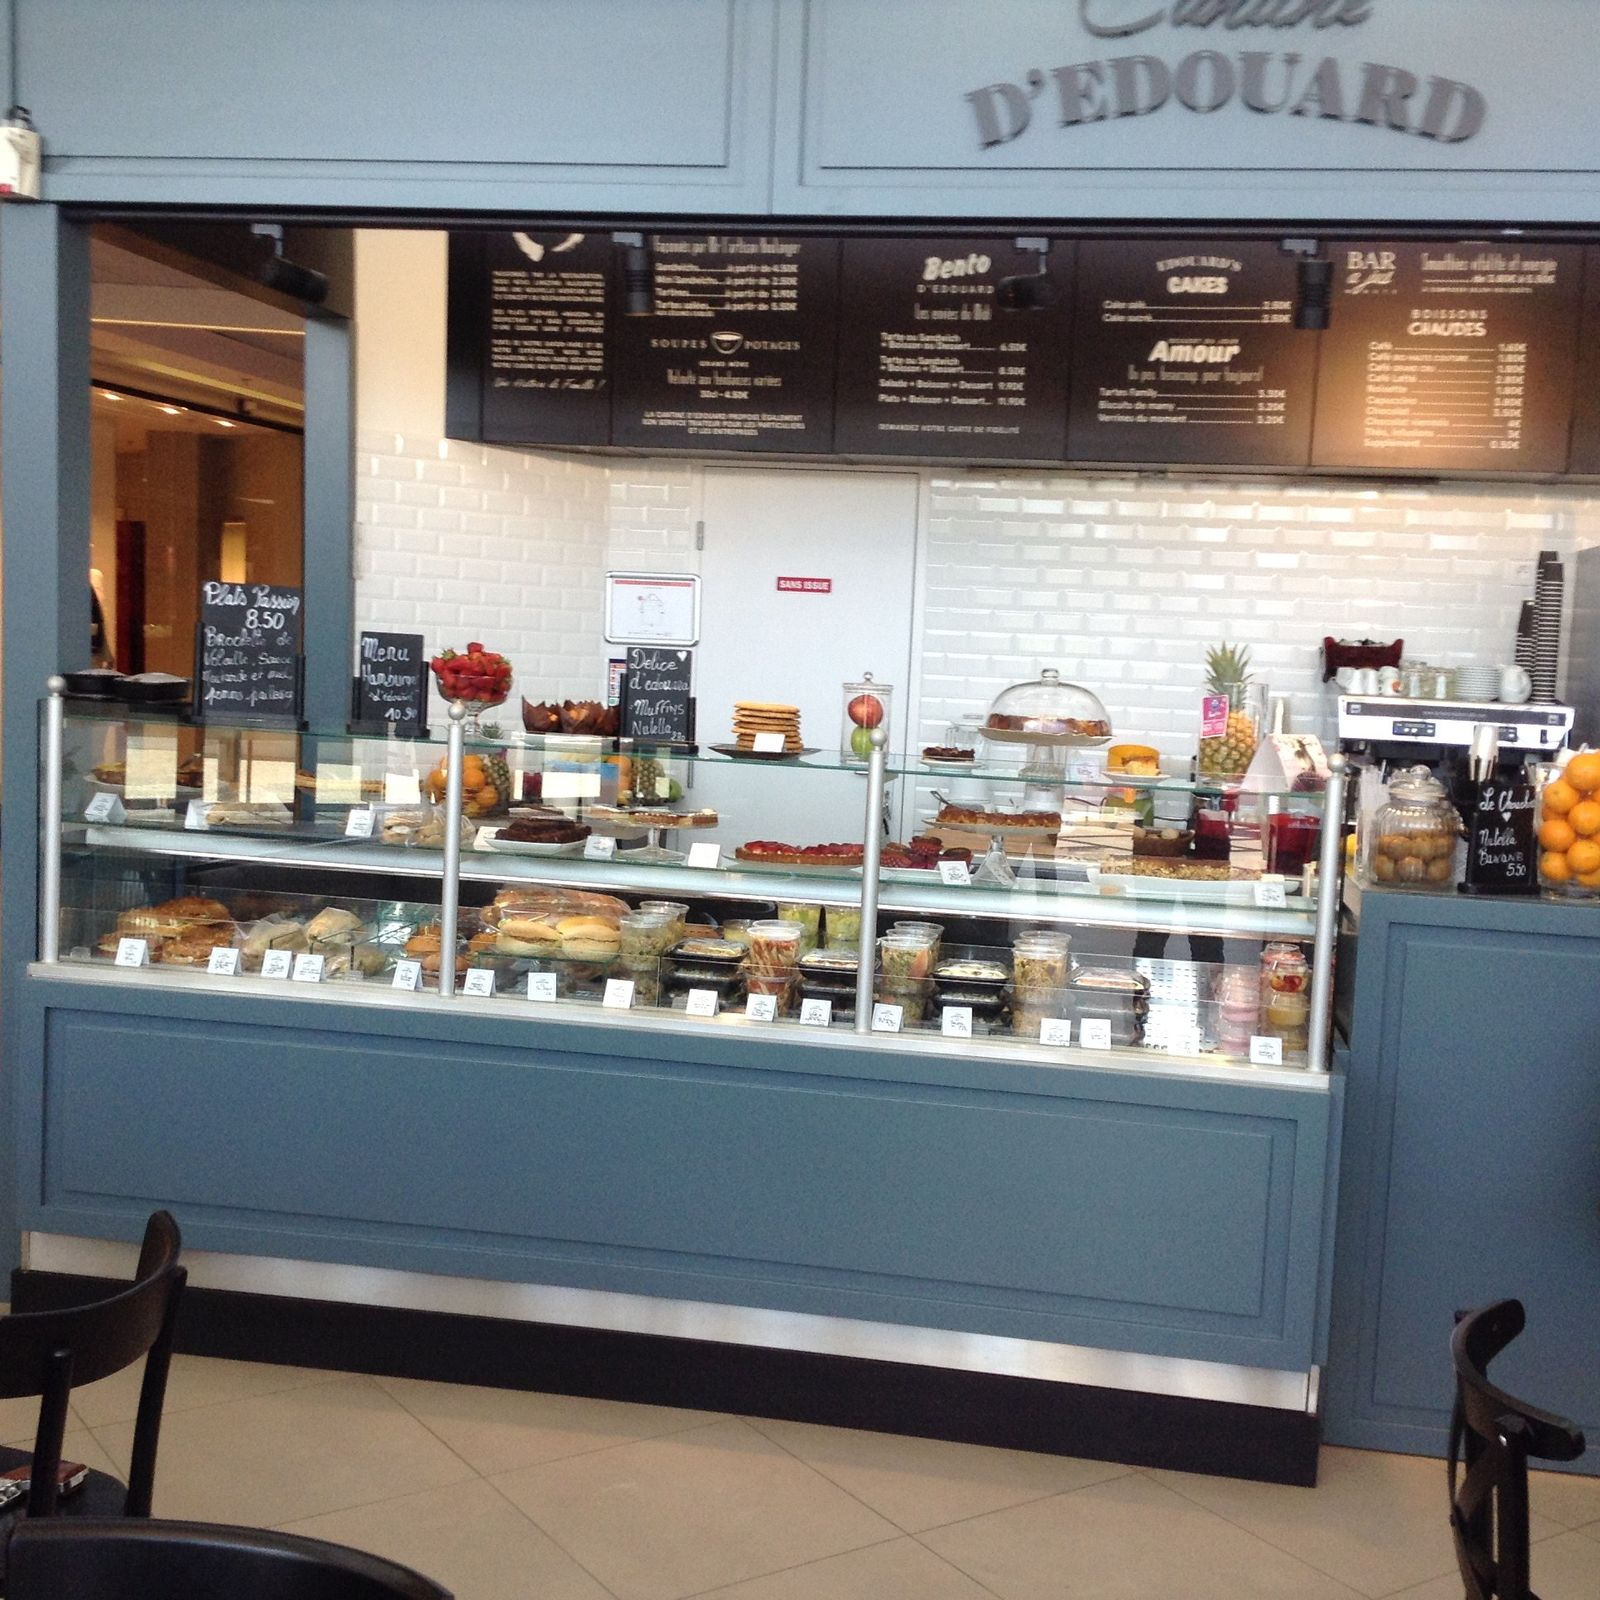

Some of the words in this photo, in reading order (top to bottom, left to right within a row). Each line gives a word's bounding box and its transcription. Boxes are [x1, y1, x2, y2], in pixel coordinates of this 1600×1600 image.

[963, 49, 1488, 151] D'EDOUARD
[923, 253, 991, 281] Bento
[1346, 251, 1396, 270] BAR
[1166, 276, 1228, 294] CAKES
[1410, 309, 1488, 319] BOISSONS
[1407, 321, 1488, 337] CHAUDES
[650, 339, 707, 349] SOUPES
[743, 341, 800, 350] POTAGES
[1147, 340, 1241, 363] Amour
[245, 609, 285, 629] 8.50
[361, 637, 410, 661] Menu
